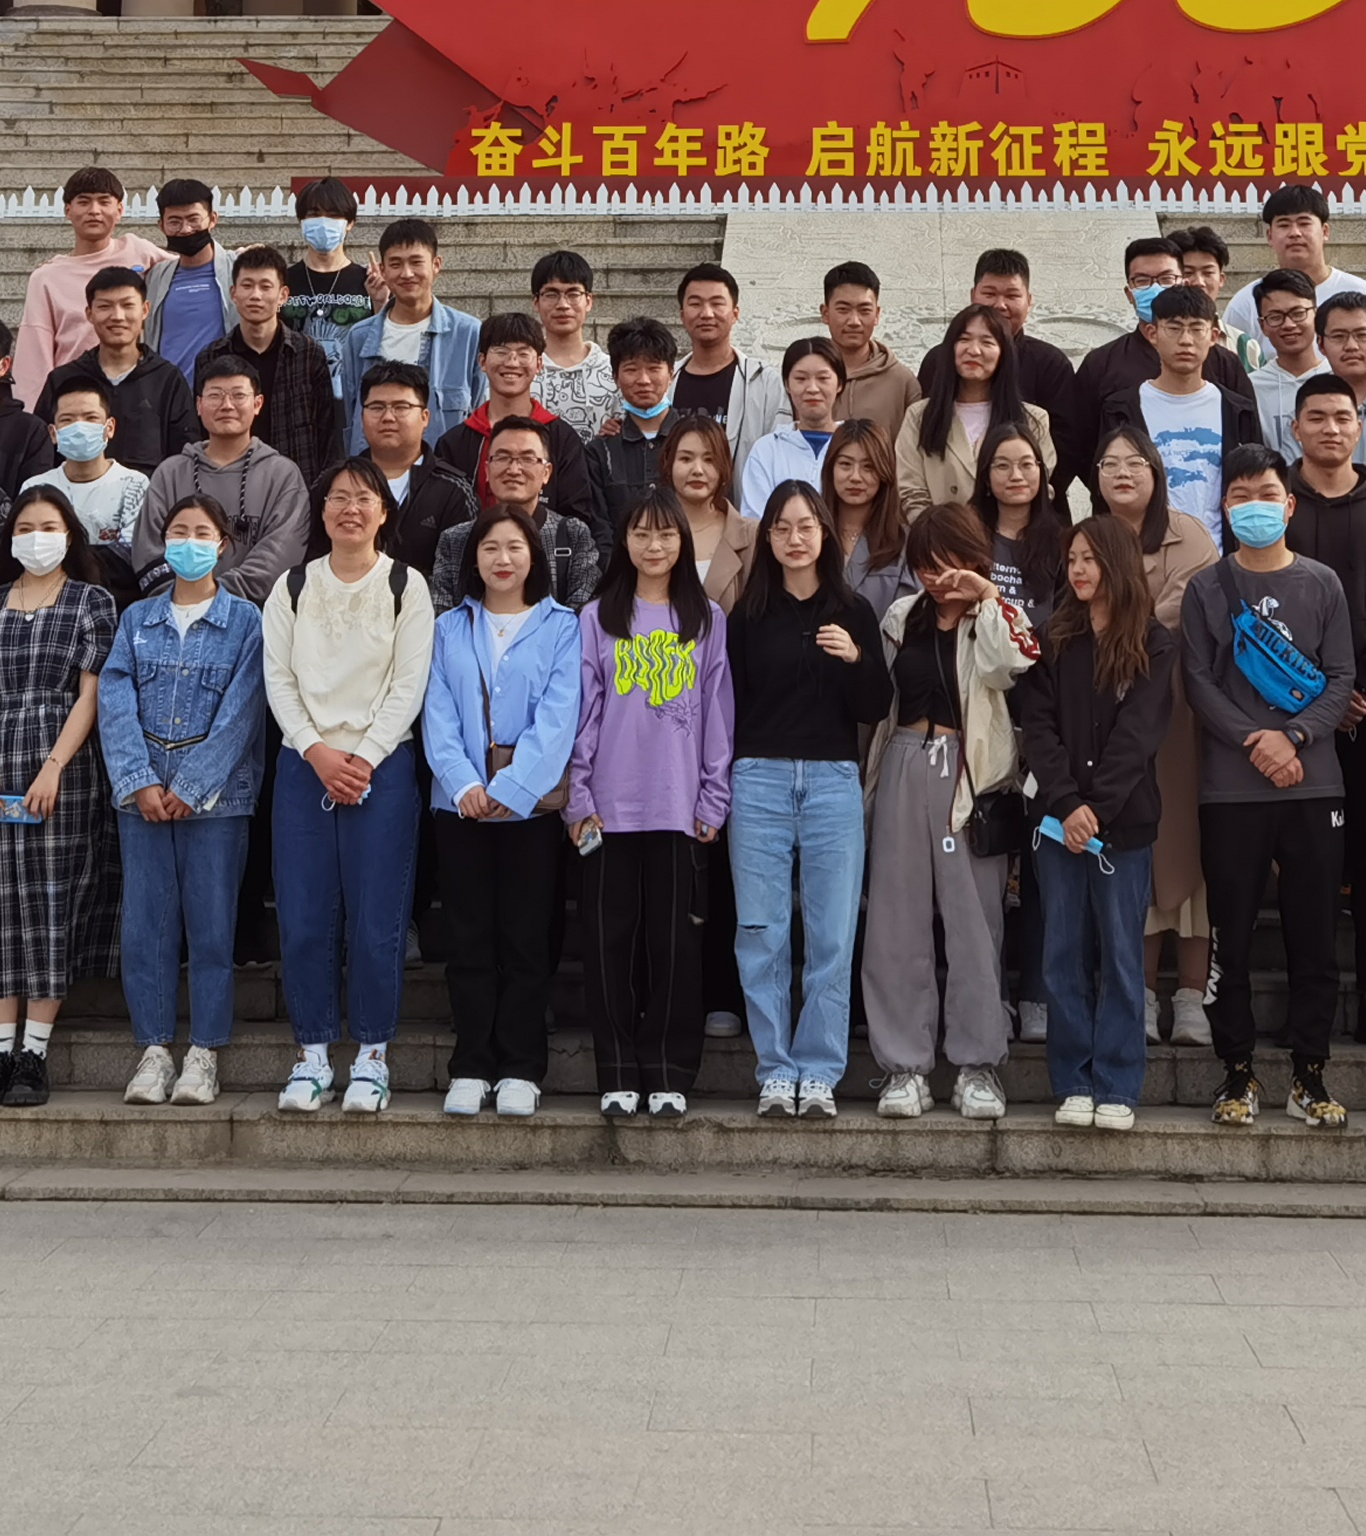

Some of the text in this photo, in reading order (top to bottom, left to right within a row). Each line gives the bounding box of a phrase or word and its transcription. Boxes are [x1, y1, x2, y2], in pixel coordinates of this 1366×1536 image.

[470, 121, 771, 178] 奋斗百年路
[805, 120, 1110, 177] 启航新征程
